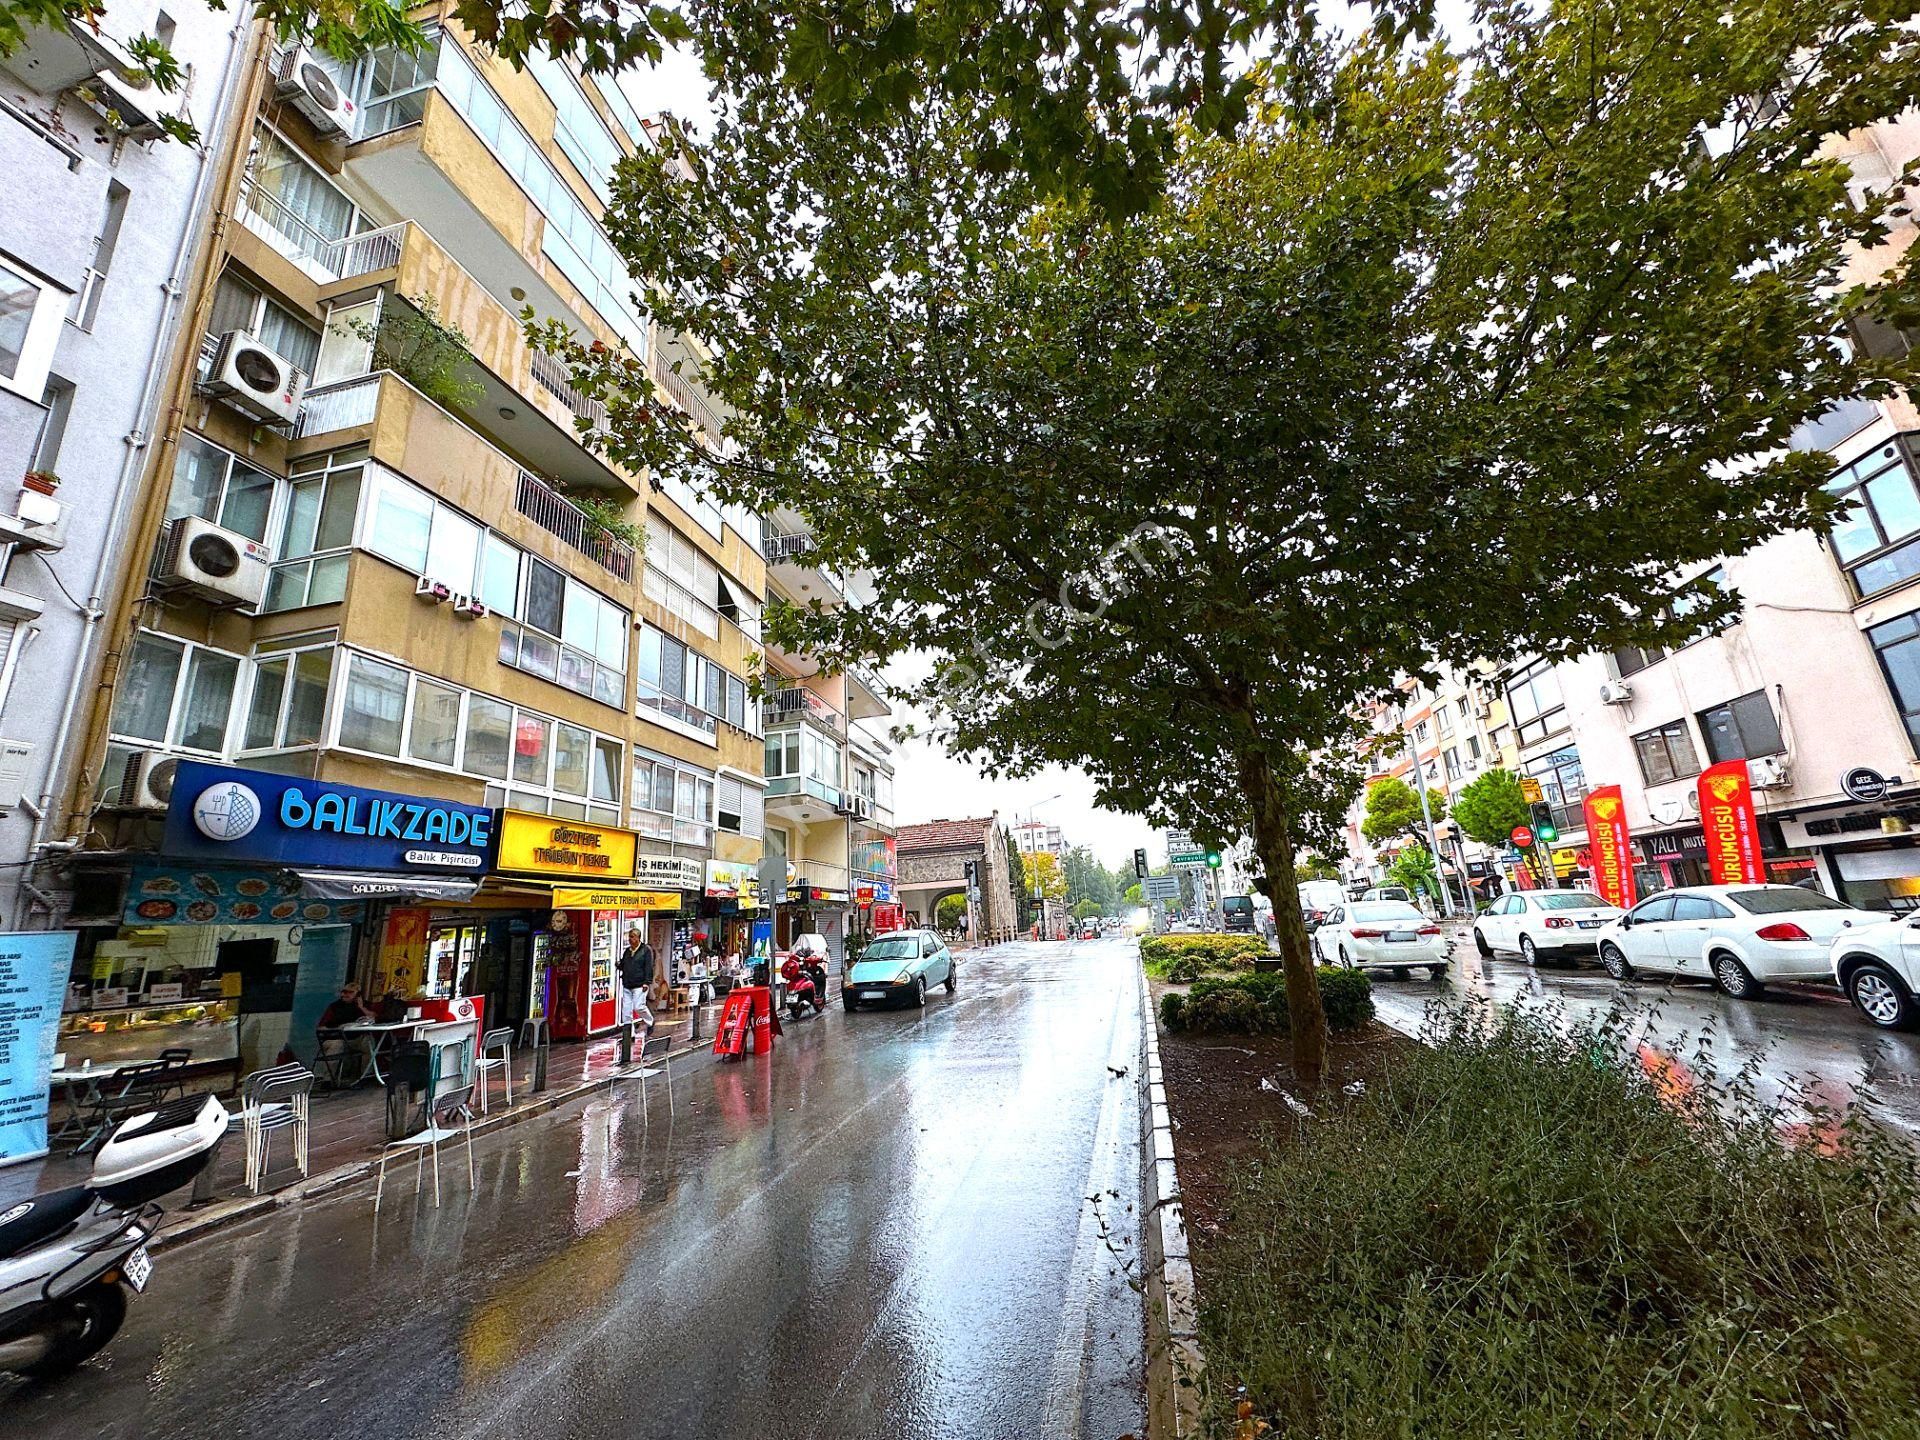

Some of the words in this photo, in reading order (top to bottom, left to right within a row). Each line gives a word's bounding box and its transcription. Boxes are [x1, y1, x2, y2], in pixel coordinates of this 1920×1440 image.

[281, 787, 490, 847] BALIKZADE
[554, 826, 602, 848] GÖZTEPE
[1649, 836, 1678, 854] YALI
[1682, 835, 1706, 849] MUTF
[409, 851, 436, 863] Balık
[440, 853, 479, 866] Pişiricisi
[582, 852, 612, 869] TEKEL
[650, 859, 682, 871] HEKİMİ
[1594, 822, 1620, 890] DÜRÜMCÜSÜ
